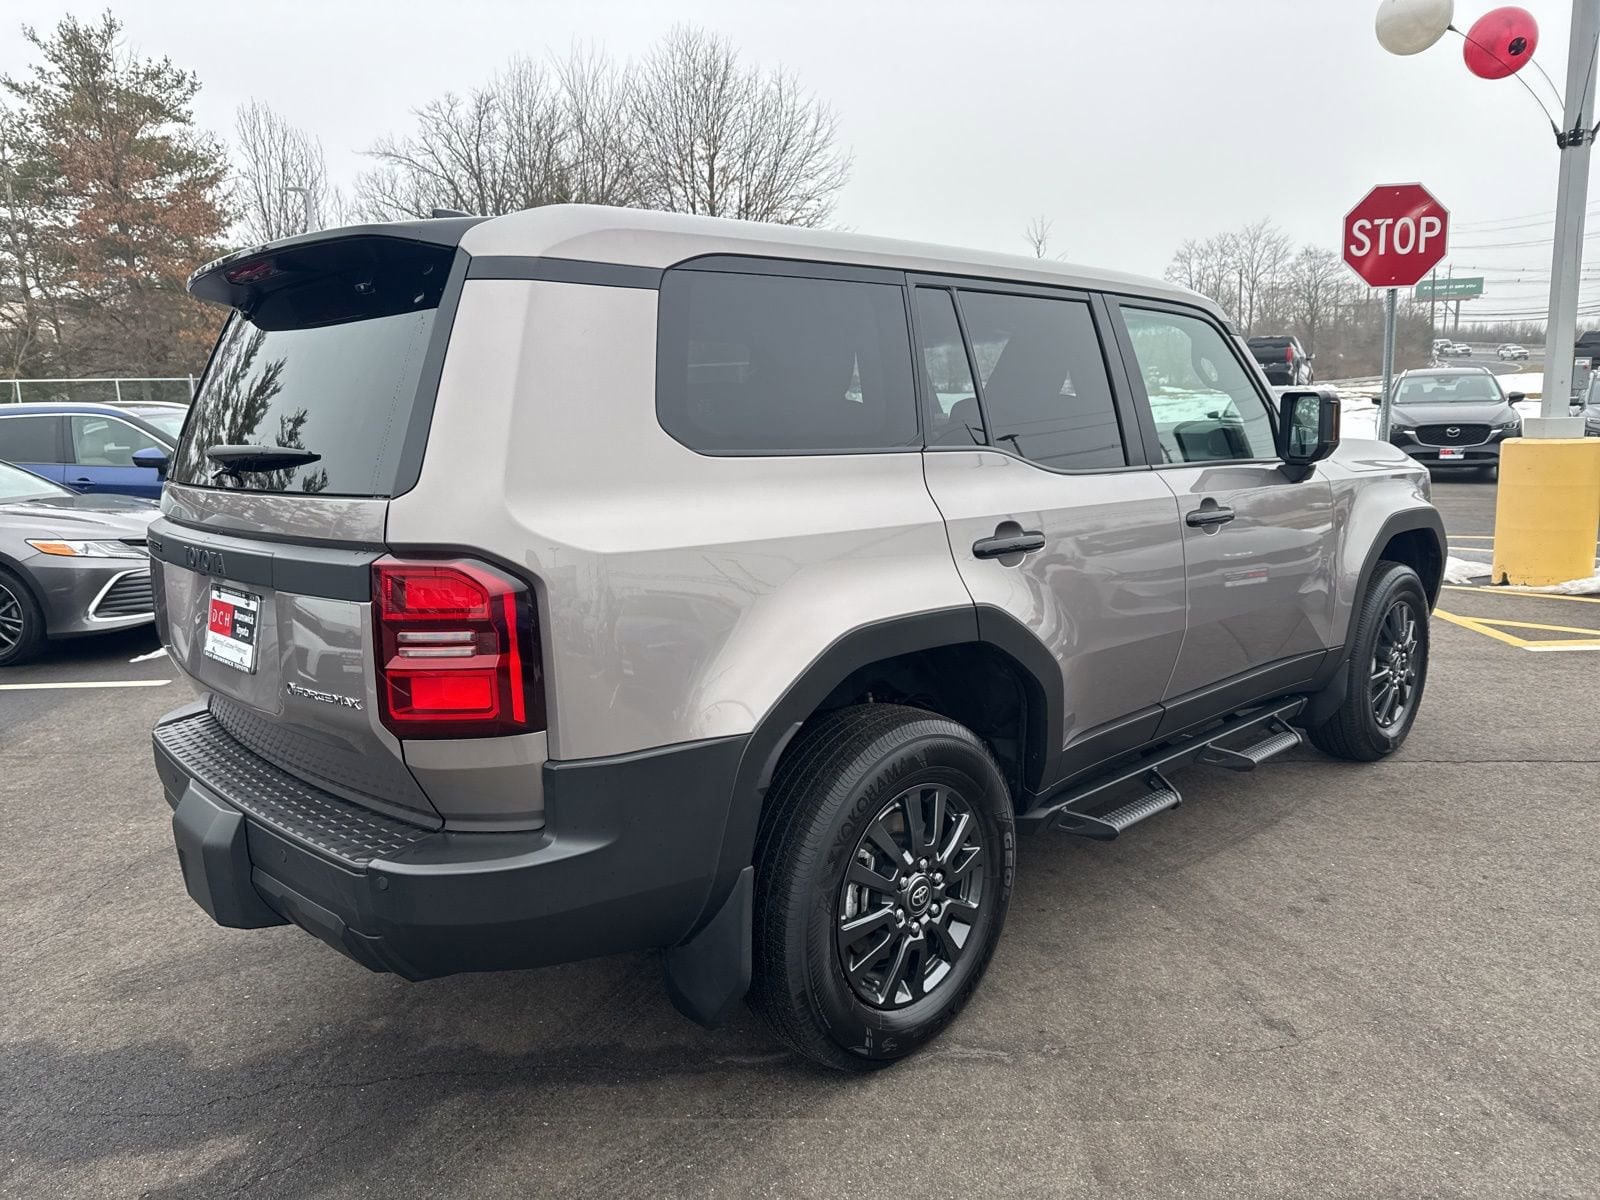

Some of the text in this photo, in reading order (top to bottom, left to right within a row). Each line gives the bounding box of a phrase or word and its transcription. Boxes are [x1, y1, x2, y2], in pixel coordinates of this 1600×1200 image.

[1350, 216, 1441, 257] STOP
[184, 546, 226, 576] TOYOTA
[212, 608, 231, 627] DCH
[236, 623, 249, 637] Toyota
[833, 756, 911, 851] YOKOHAMA
